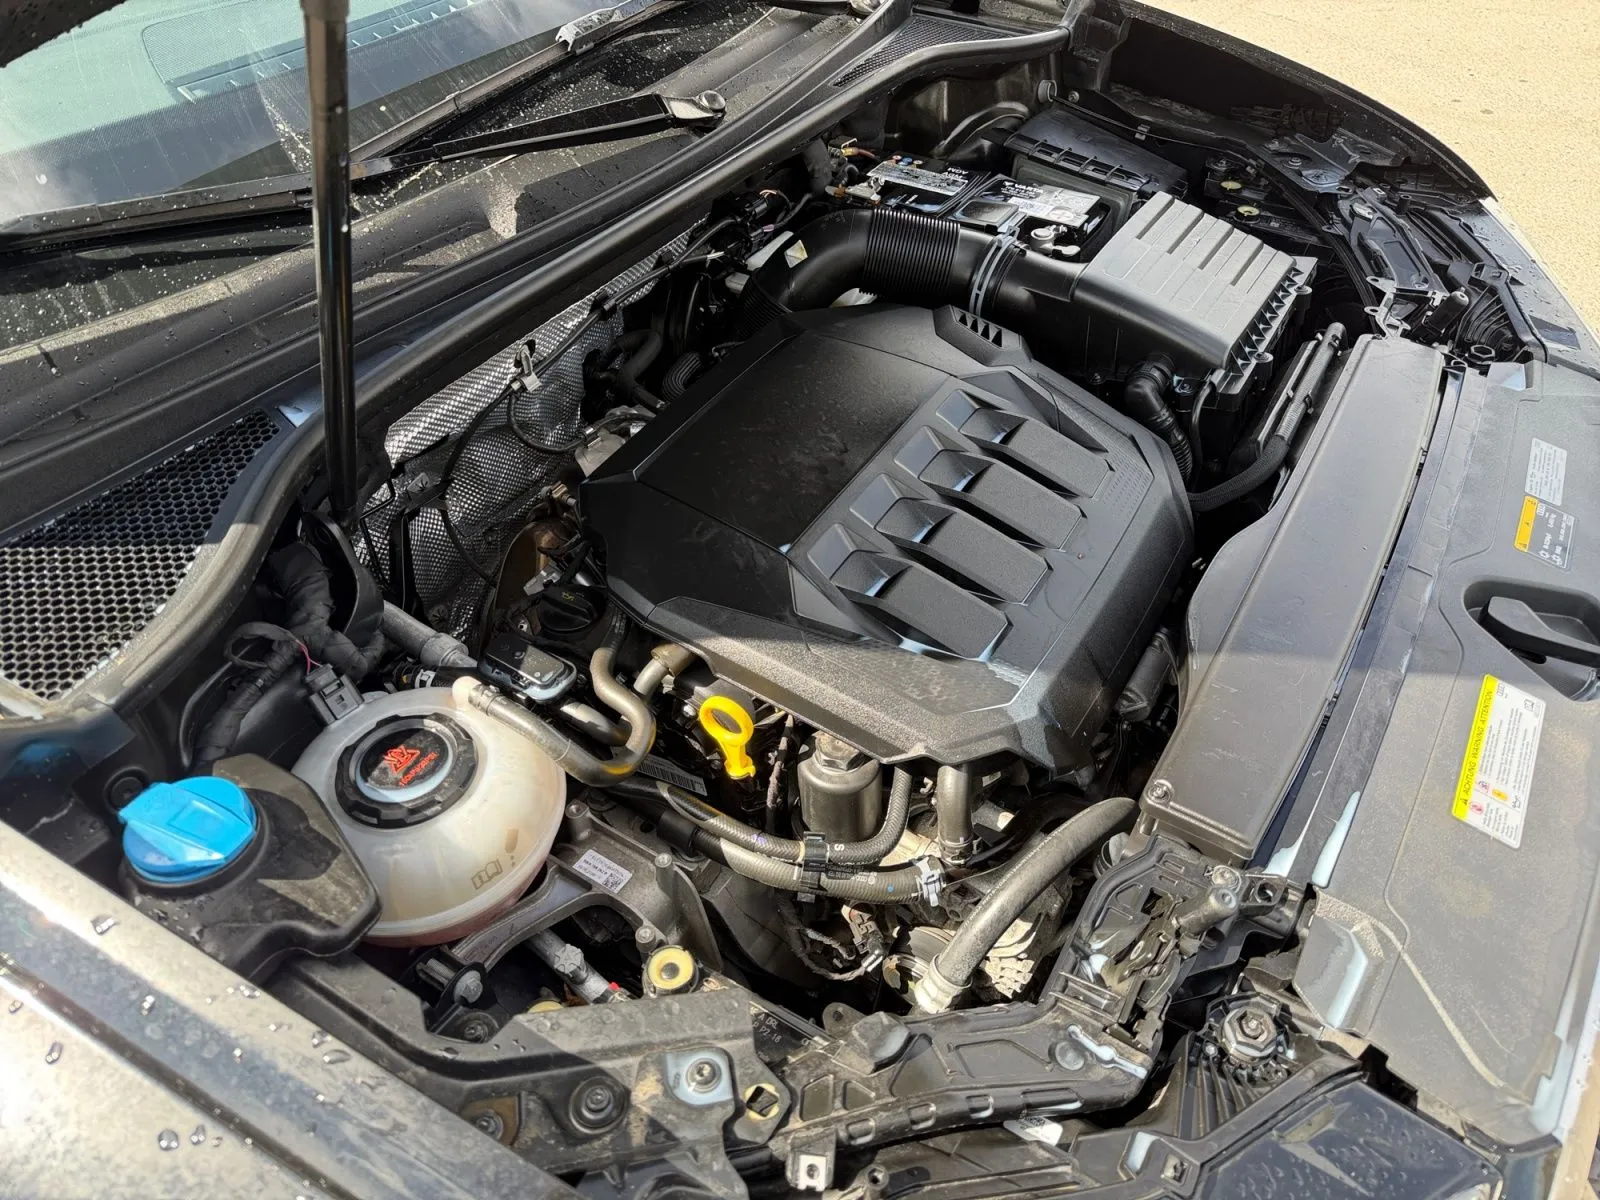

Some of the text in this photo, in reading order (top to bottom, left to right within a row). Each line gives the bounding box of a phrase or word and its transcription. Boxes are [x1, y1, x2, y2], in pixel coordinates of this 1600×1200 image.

[1014, 183, 1044, 194] VARTA
[1463, 690, 1493, 796] ACHTUNG WARNING ATTENTION
